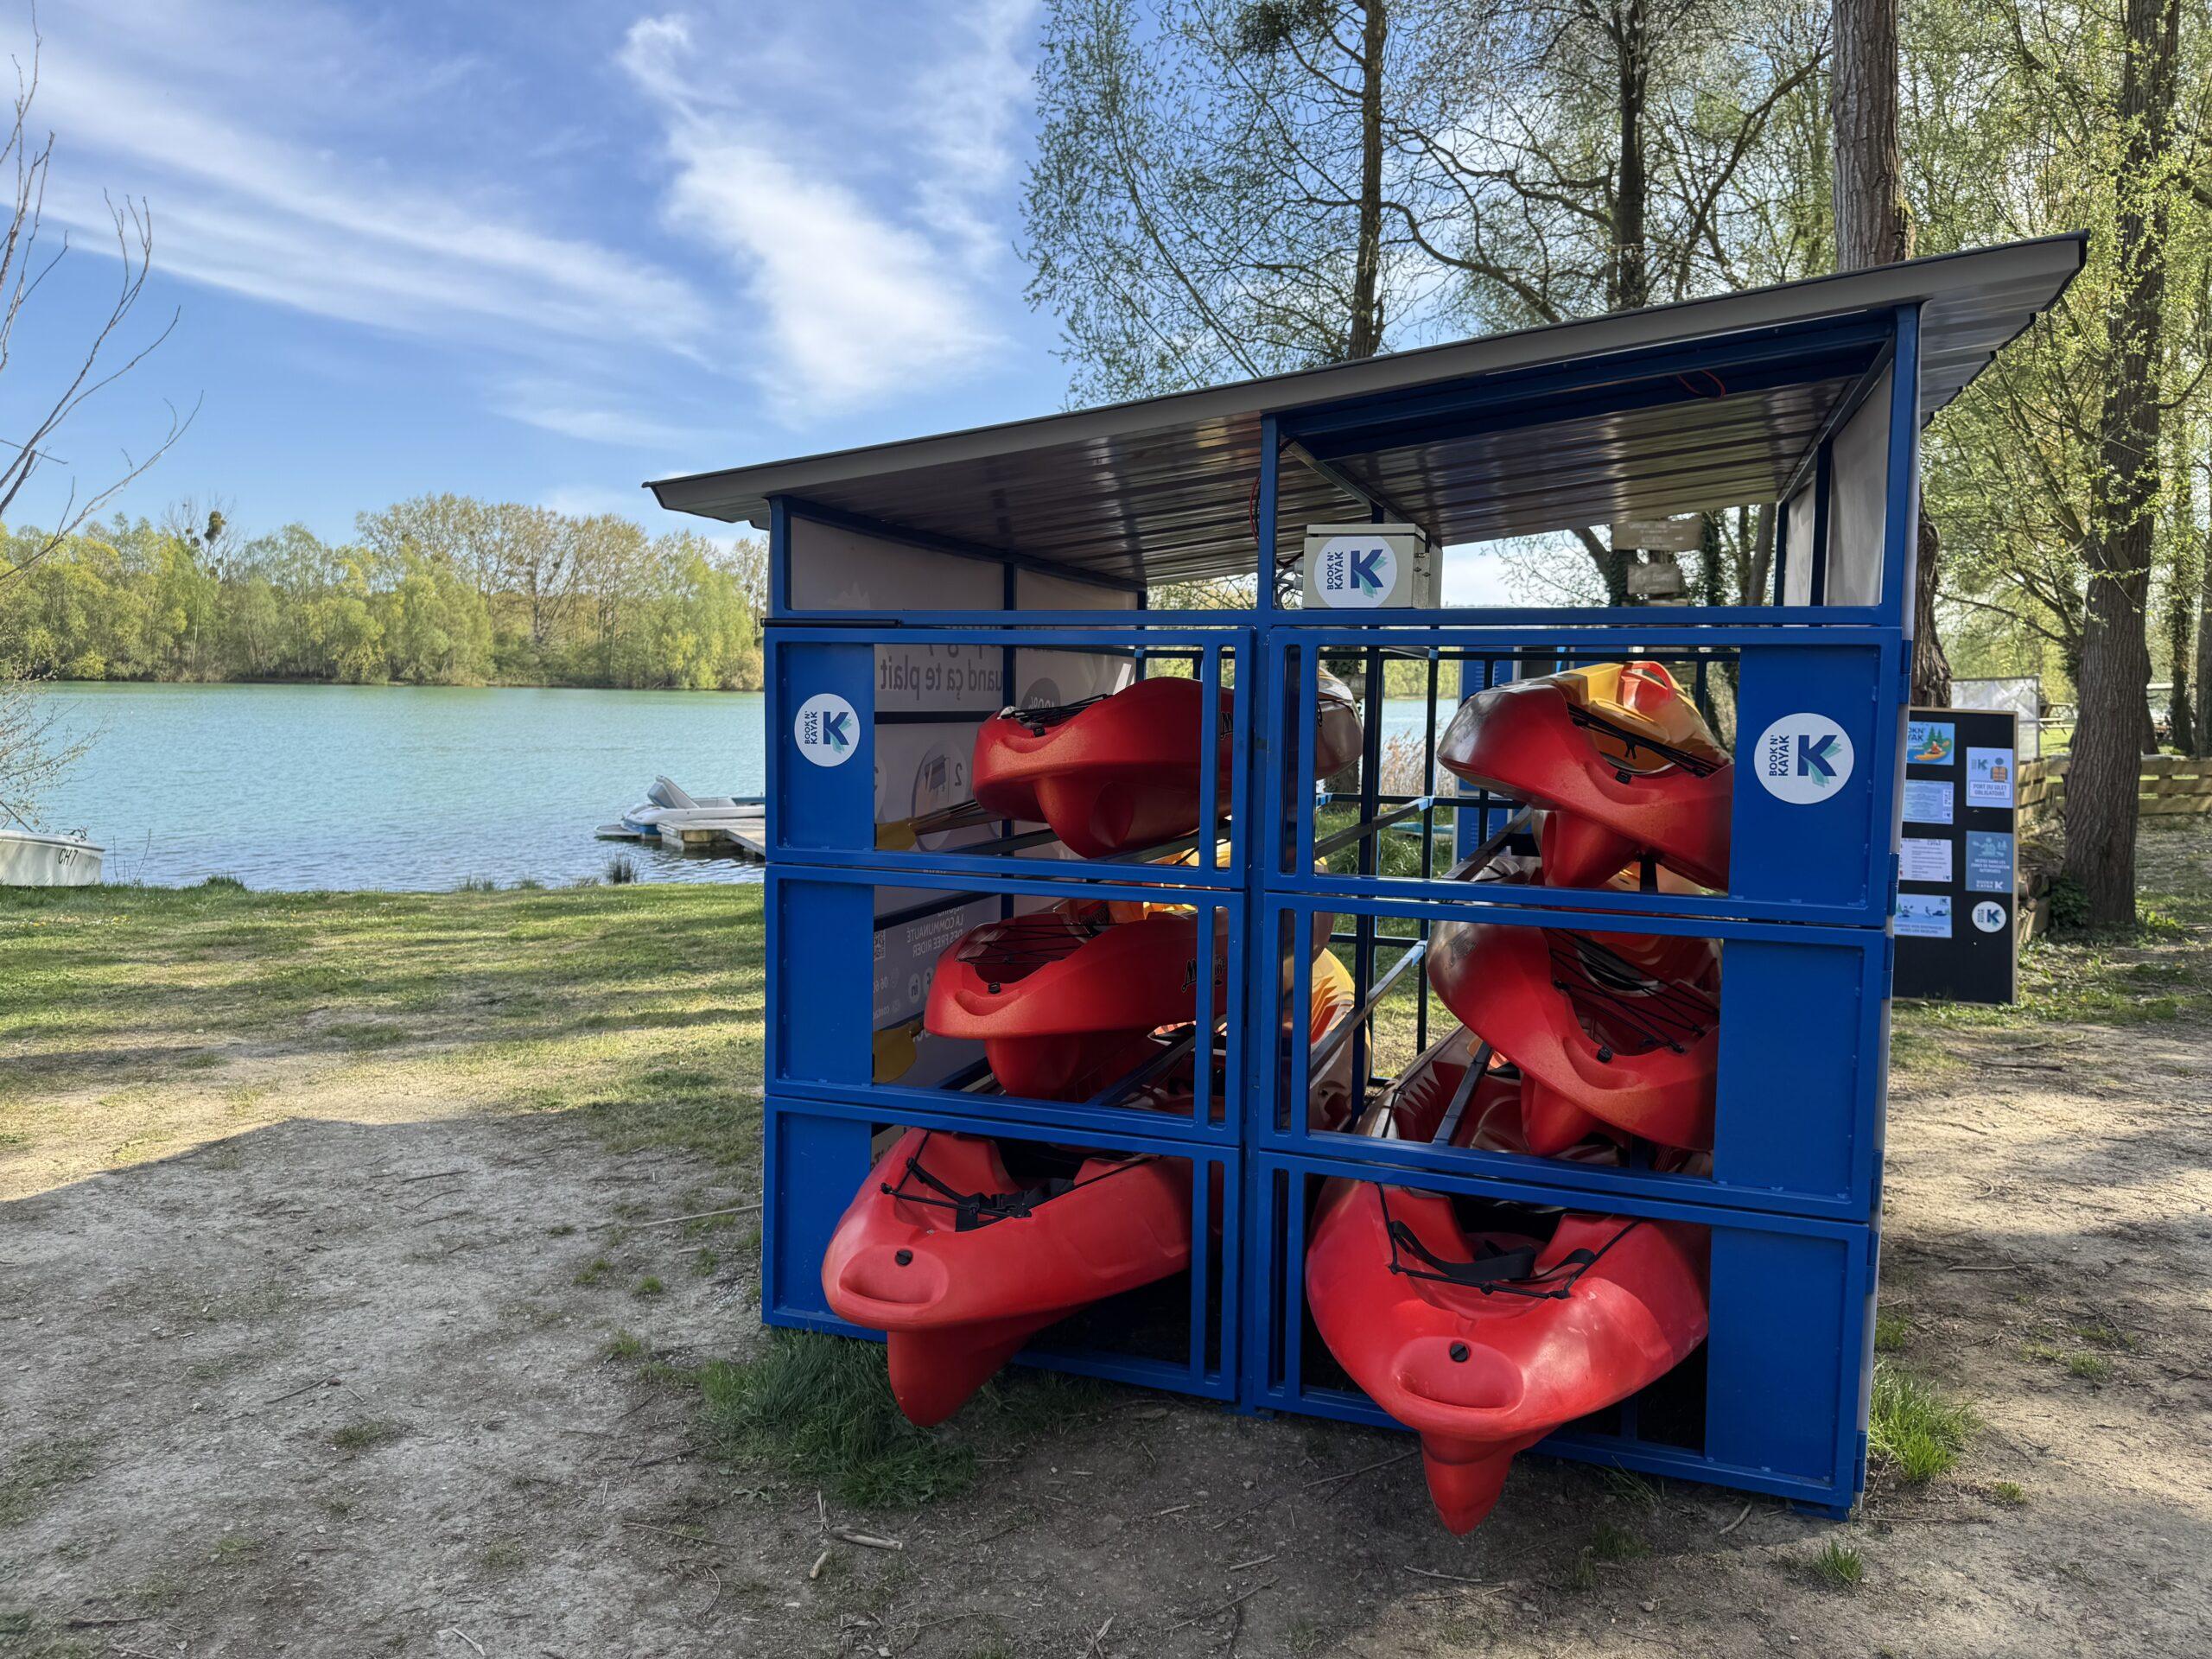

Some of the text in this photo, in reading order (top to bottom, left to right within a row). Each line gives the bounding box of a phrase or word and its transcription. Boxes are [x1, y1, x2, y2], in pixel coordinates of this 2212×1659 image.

[1334, 551, 1344, 589] KAYAK
[1350, 549, 1384, 588] K
[823, 711, 849, 746] K
[1769, 747, 1777, 777] BOOK
[1777, 734, 1789, 776] KAYAK
[1797, 734, 1838, 777] K
